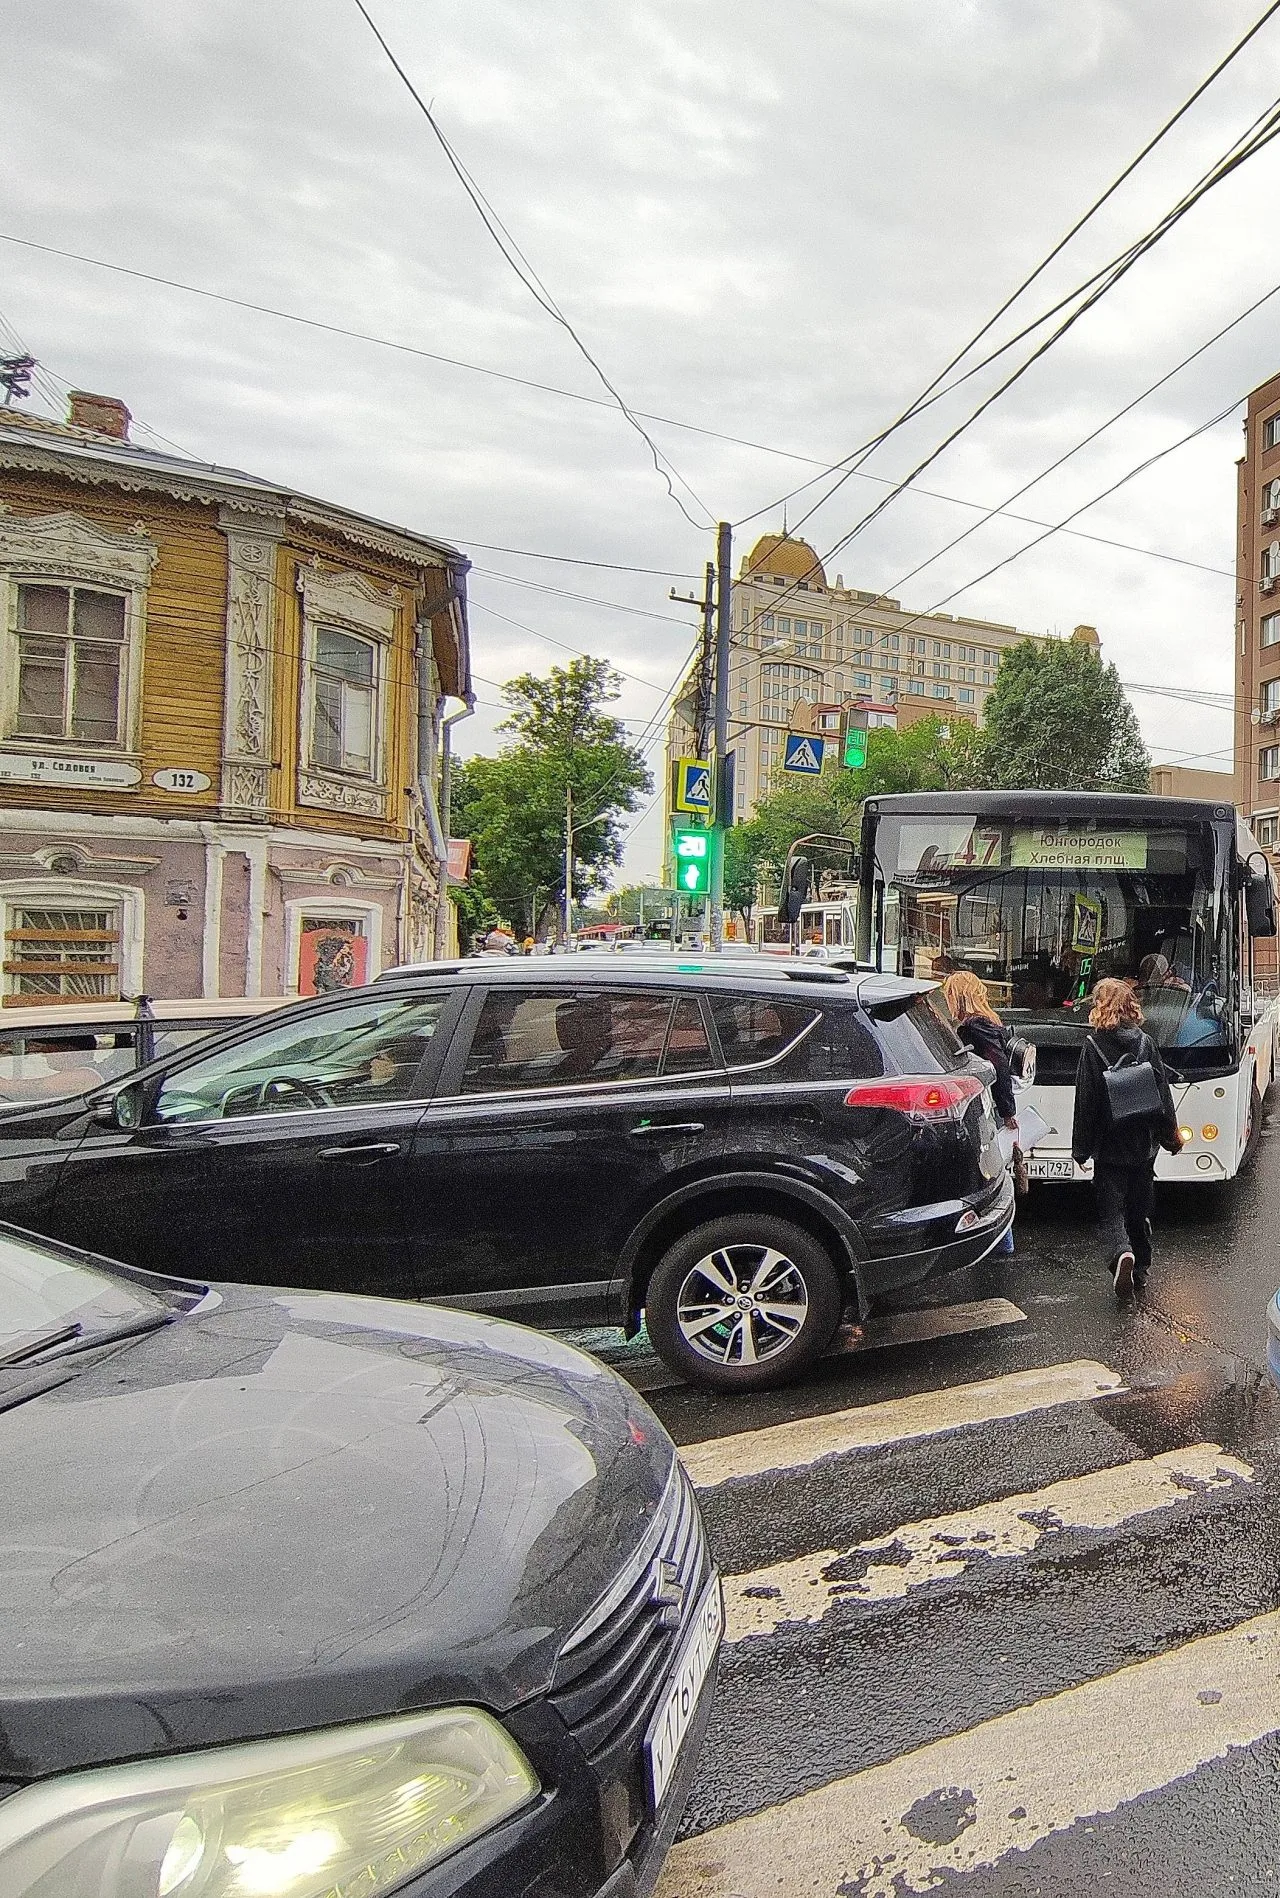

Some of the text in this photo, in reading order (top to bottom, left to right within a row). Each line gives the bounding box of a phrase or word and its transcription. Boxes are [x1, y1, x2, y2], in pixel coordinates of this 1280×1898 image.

[32, 761, 49, 770] ул.
[171, 773, 194, 788] 132
[954, 832, 1000, 865] 47
[1040, 834, 1121, 850] Юнгородок
[1029, 852, 1129, 867] Хлебная плщ.
[1049, 1162, 1069, 1173] 797
